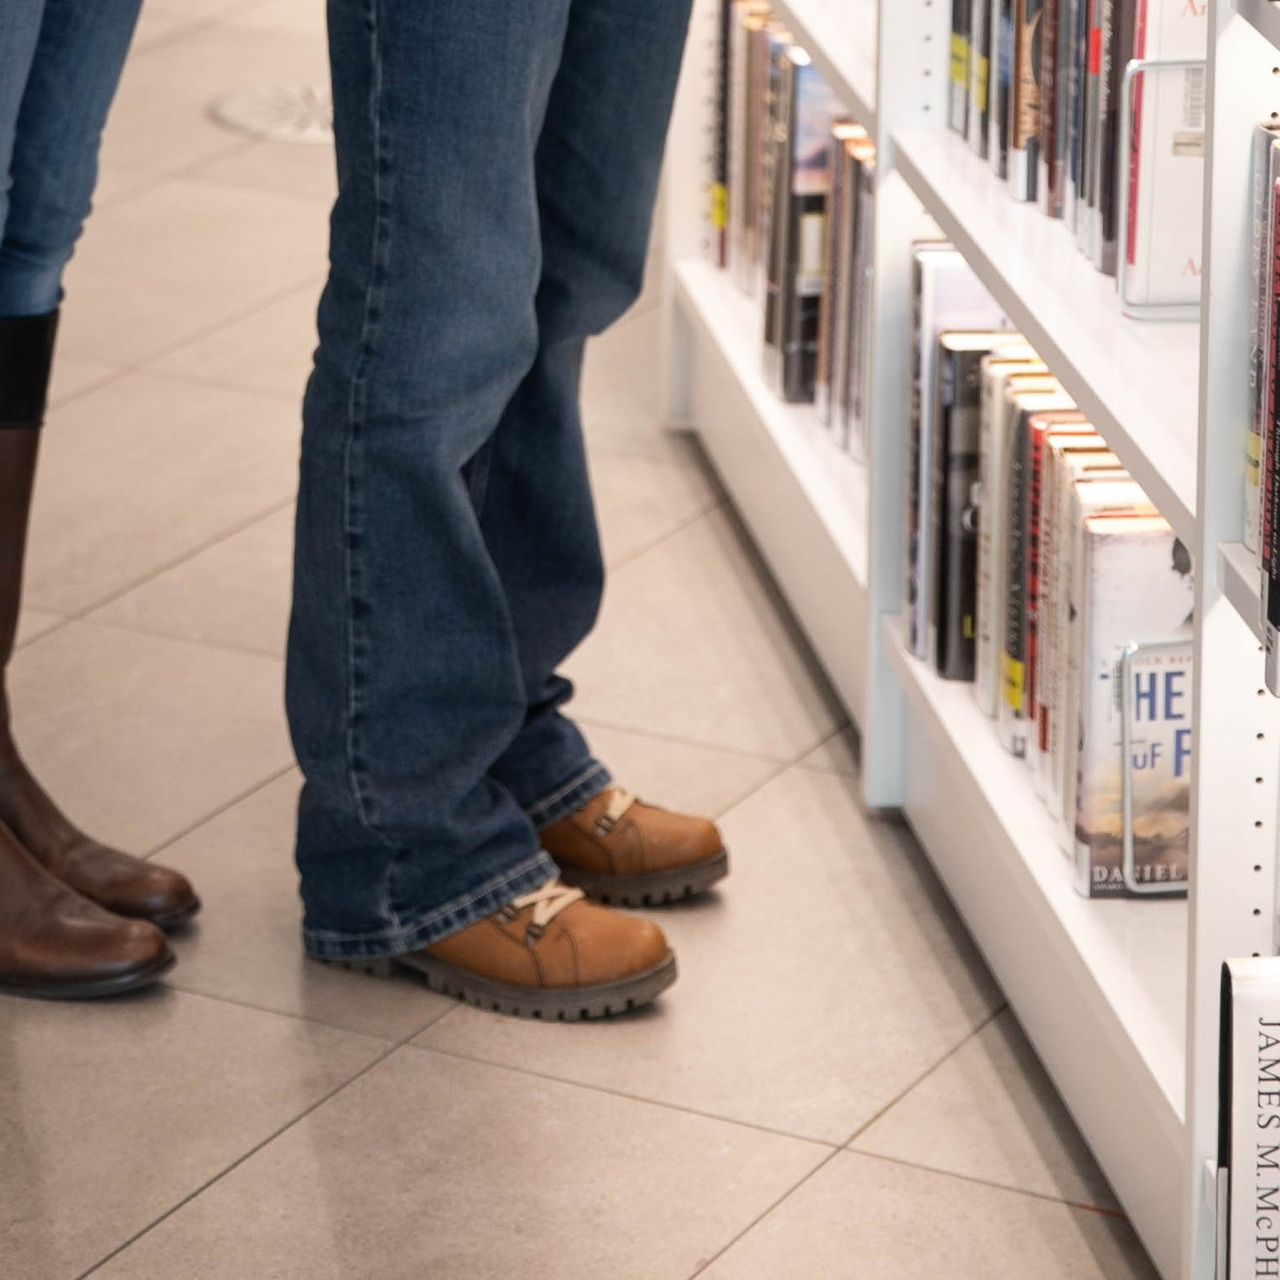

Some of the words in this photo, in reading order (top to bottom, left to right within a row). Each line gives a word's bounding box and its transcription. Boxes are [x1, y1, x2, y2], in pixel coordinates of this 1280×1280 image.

[1099, 669, 1187, 721] HE
[1256, 1016, 1280, 1132] JAMES
[1253, 1143, 1280, 1179] M.
[1252, 1184, 1280, 1280] McPH
